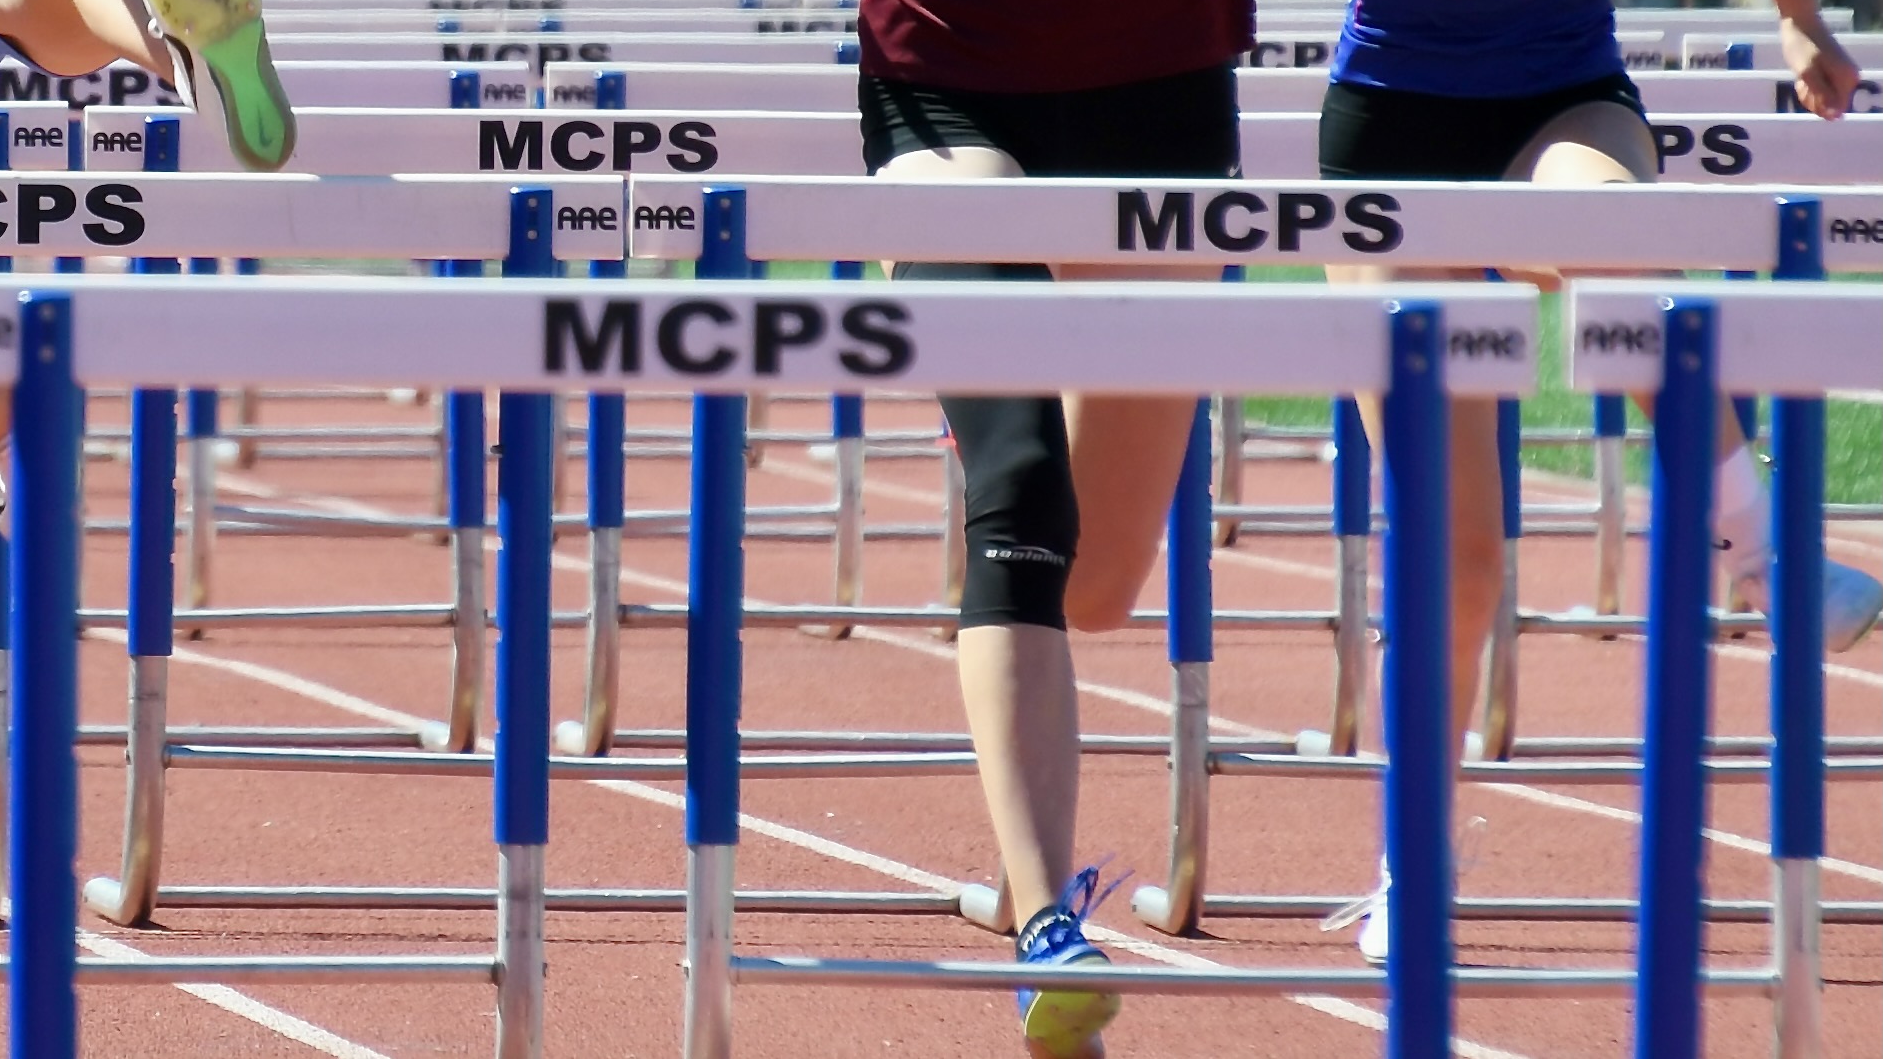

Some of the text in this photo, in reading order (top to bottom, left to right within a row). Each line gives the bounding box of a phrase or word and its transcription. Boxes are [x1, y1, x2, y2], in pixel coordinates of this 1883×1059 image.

[479, 120, 719, 172] MCPS
[1118, 189, 1404, 254] MCPS
[543, 299, 915, 378] MCPS
